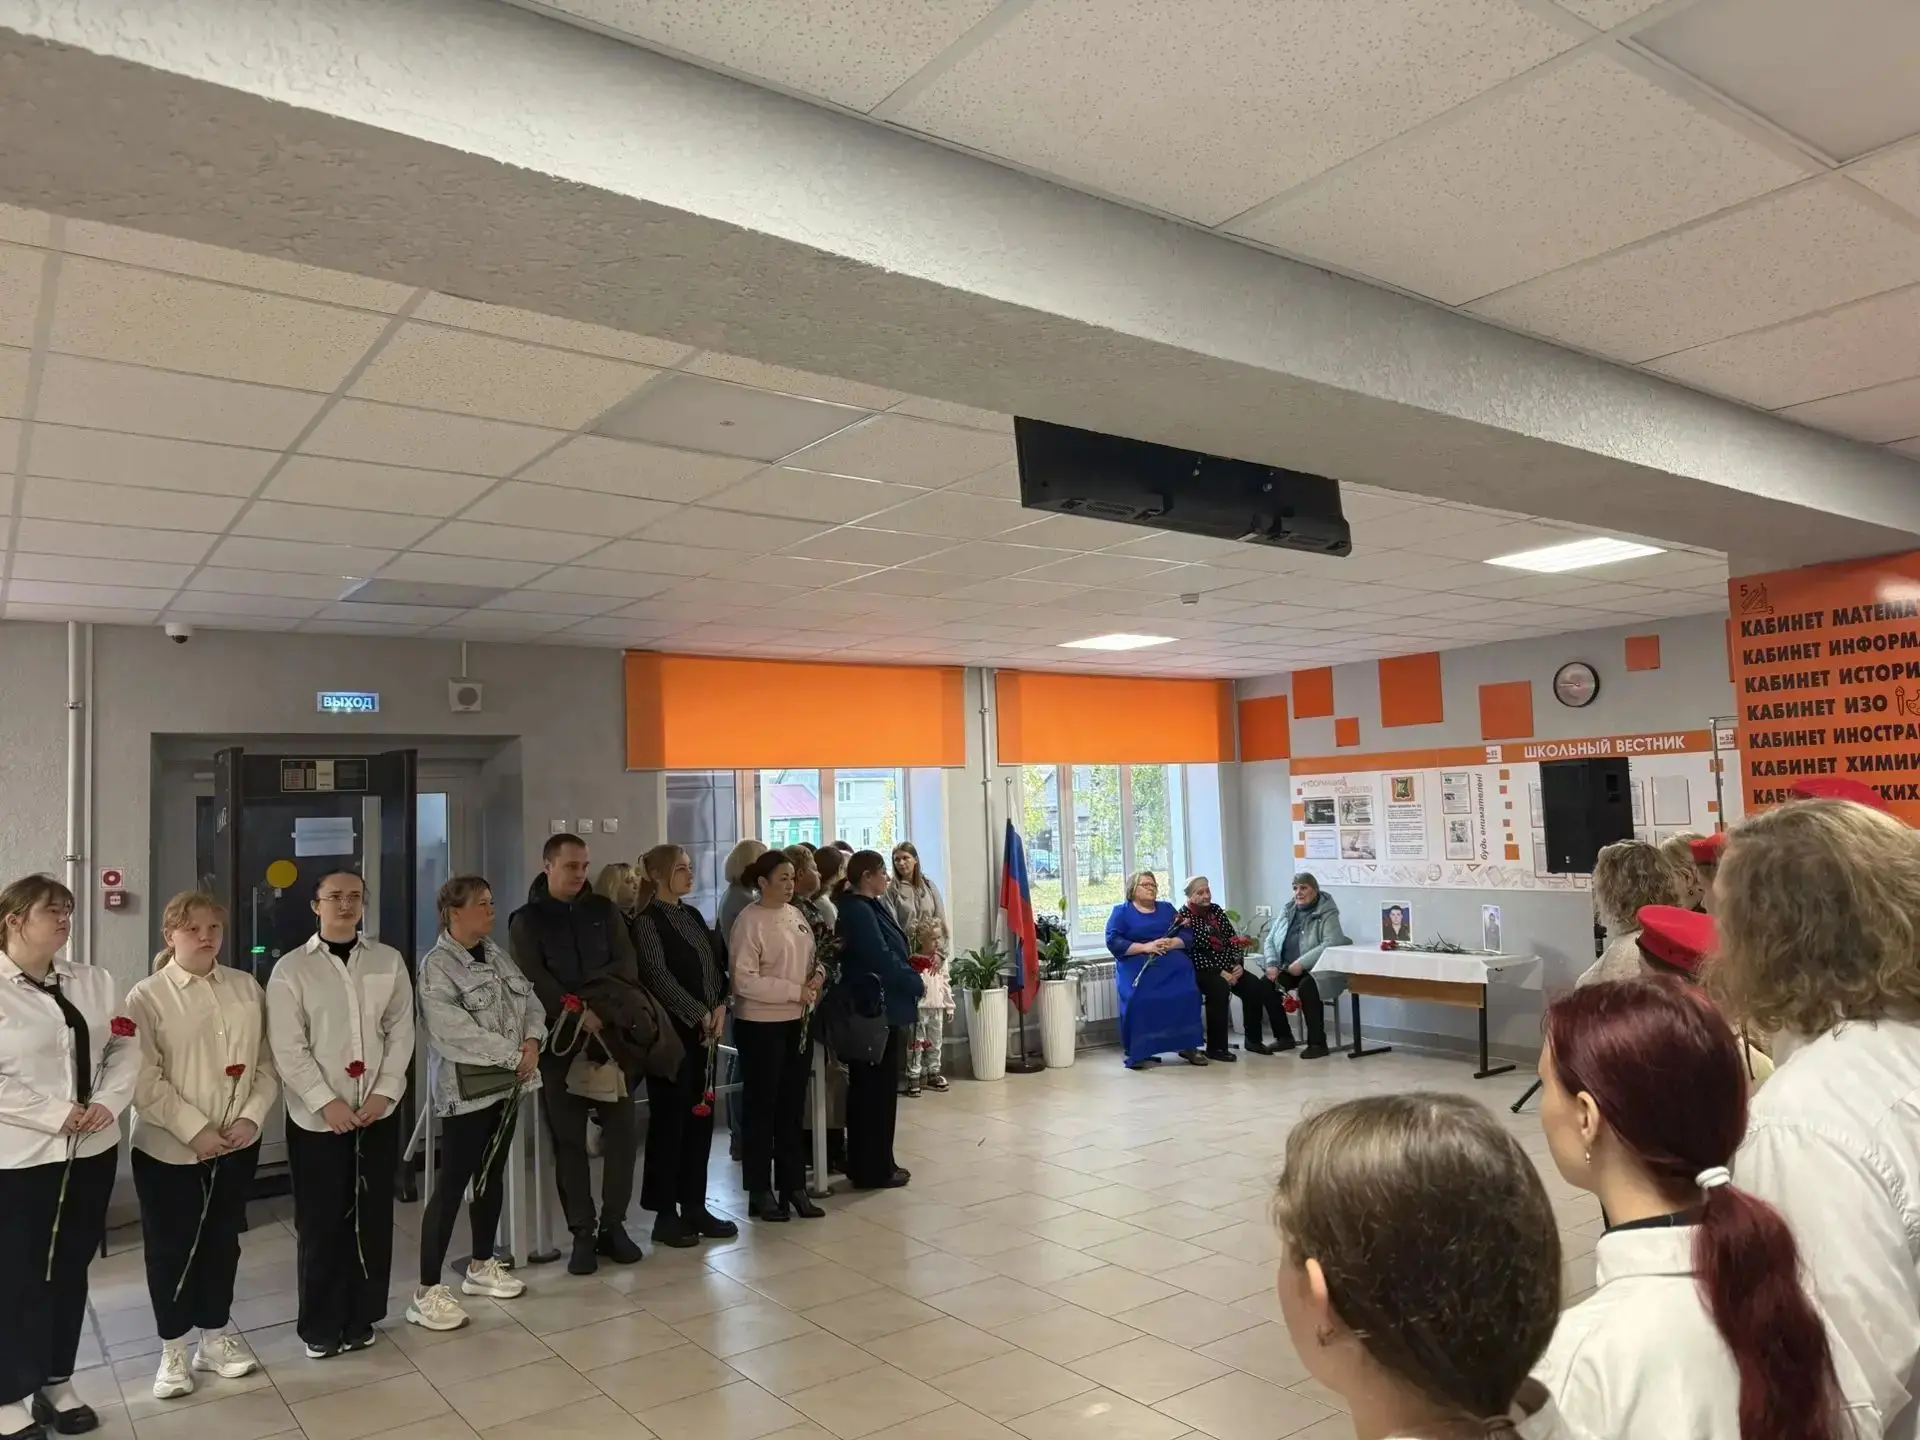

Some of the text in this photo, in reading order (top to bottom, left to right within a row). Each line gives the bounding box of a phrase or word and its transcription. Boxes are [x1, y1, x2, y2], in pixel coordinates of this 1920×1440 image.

[1741, 599, 1920, 637] КАБИНЕТ МАТЕМА
[1743, 631, 1920, 665] КАБИНЕТ ИНФОРМ
[1745, 670, 1830, 693] КАБИНЕТ
[323, 696, 372, 709] ВЫХОД
[1747, 694, 1888, 721] КАБИНЕТ ИЗО
[1524, 735, 1685, 758] ШКОЛЬНЫЙ ВЕСТНИК
[1749, 723, 1920, 749] КАБИНЕТ ИНОСТРА
[1751, 757, 1837, 777] КАБИНЕТ
